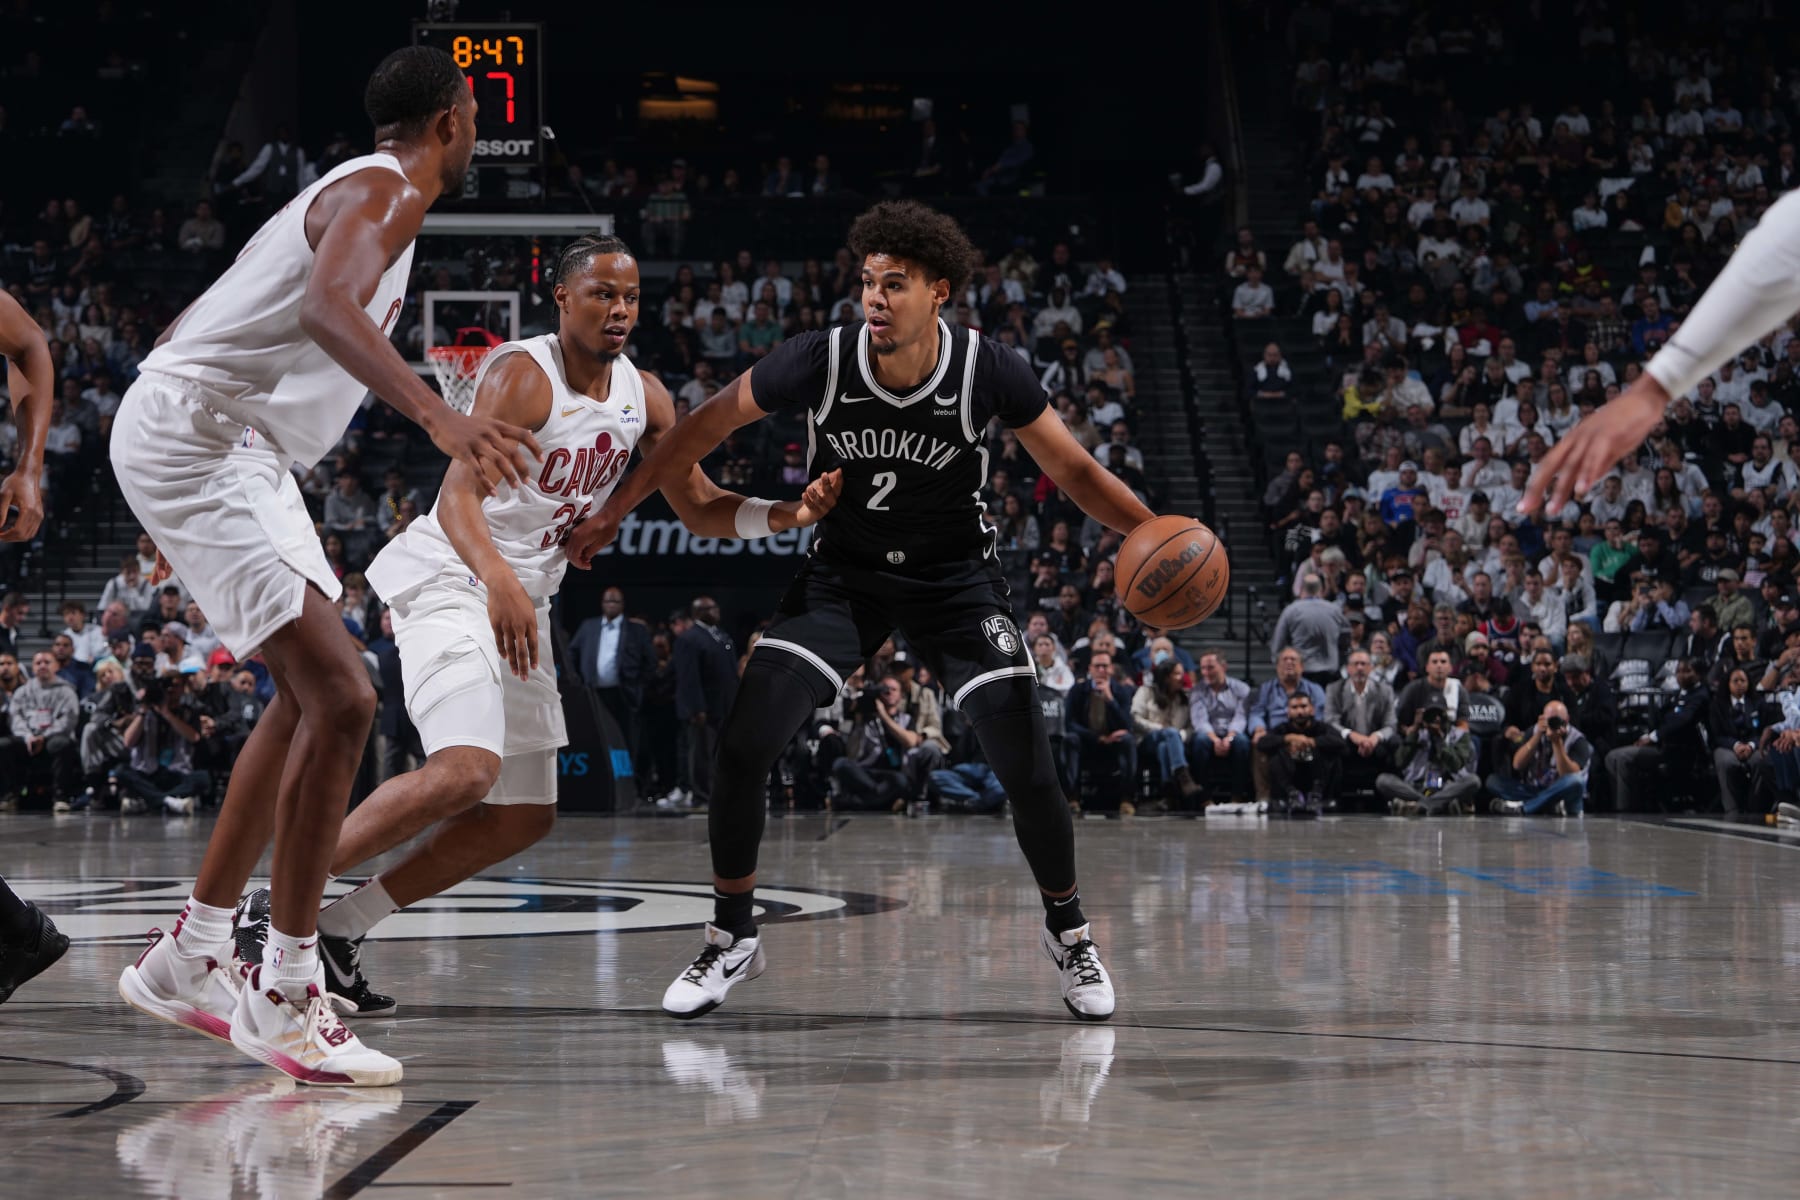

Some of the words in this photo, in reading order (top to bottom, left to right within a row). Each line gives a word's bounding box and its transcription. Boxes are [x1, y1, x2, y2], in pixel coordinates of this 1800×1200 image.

[453, 36, 524, 68] 8:47
[472, 139, 534, 156] SSOT
[826, 428, 961, 471] BROOKLYN
[538, 448, 630, 498] CAVS
[867, 471, 897, 511] 2
[1136, 541, 1205, 599] Wilson
[984, 617, 1018, 637] NETS
